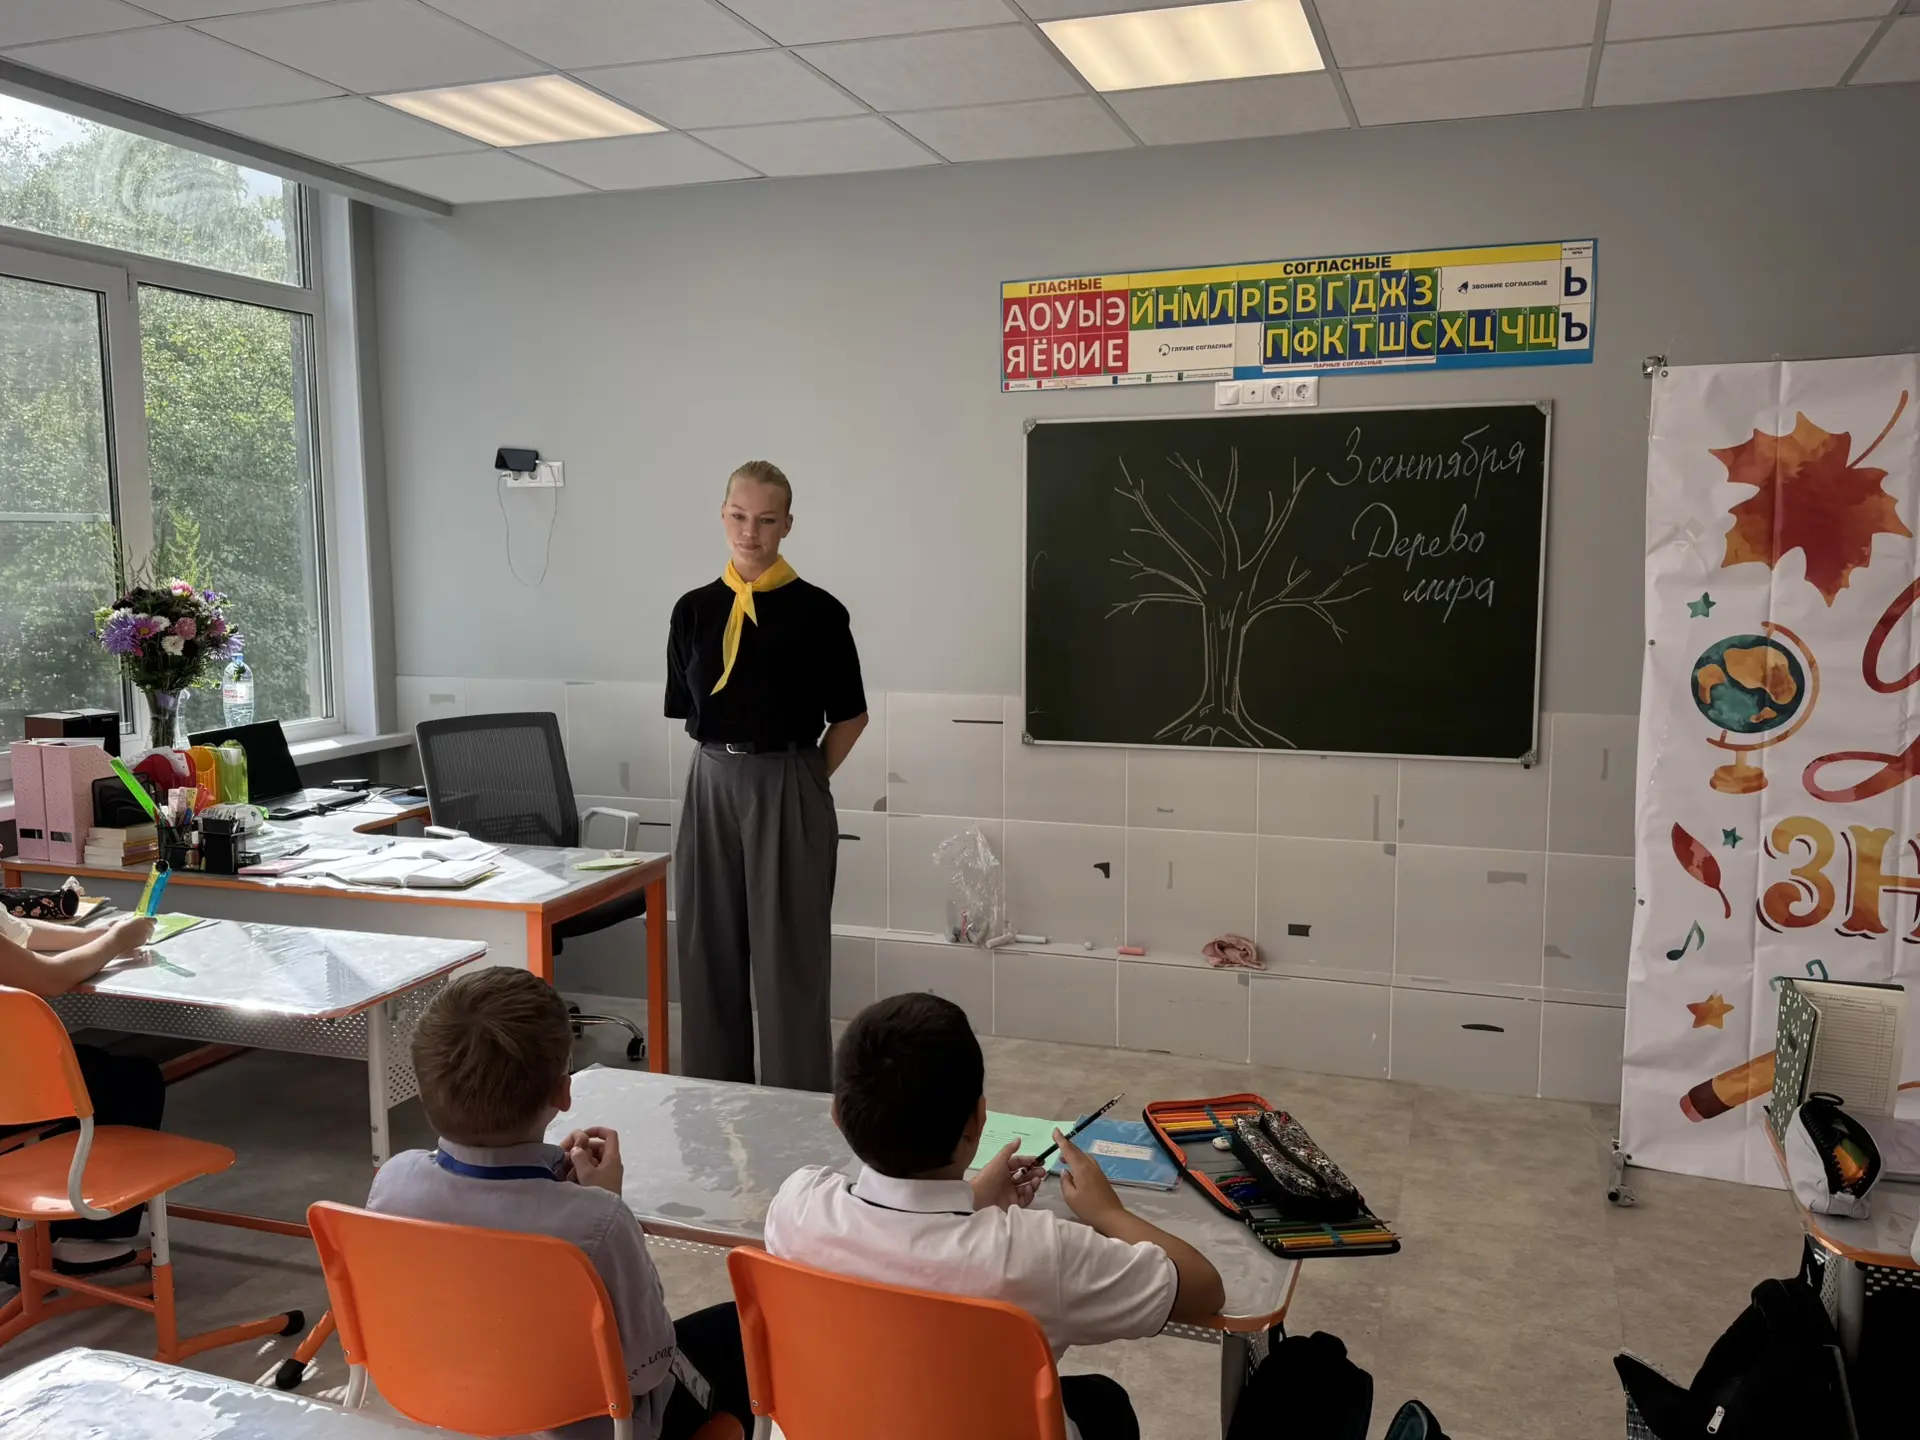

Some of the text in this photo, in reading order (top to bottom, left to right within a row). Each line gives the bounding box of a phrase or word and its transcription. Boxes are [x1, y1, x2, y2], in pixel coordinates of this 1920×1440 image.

[1283, 256, 1391, 275] СОГЛАСНЫЕ
[1028, 278, 1102, 295] ГЛАСНЫЕ
[1472, 280, 1548, 290] ЗВОНКИЕ СОГЛАСНЫЕ
[1341, 359, 1383, 368] СОГЛАСНЫЕ
[1327, 424, 1526, 499] 3 сентября
[1352, 502, 1485, 572] Дерево
[1403, 575, 1495, 624] мира
